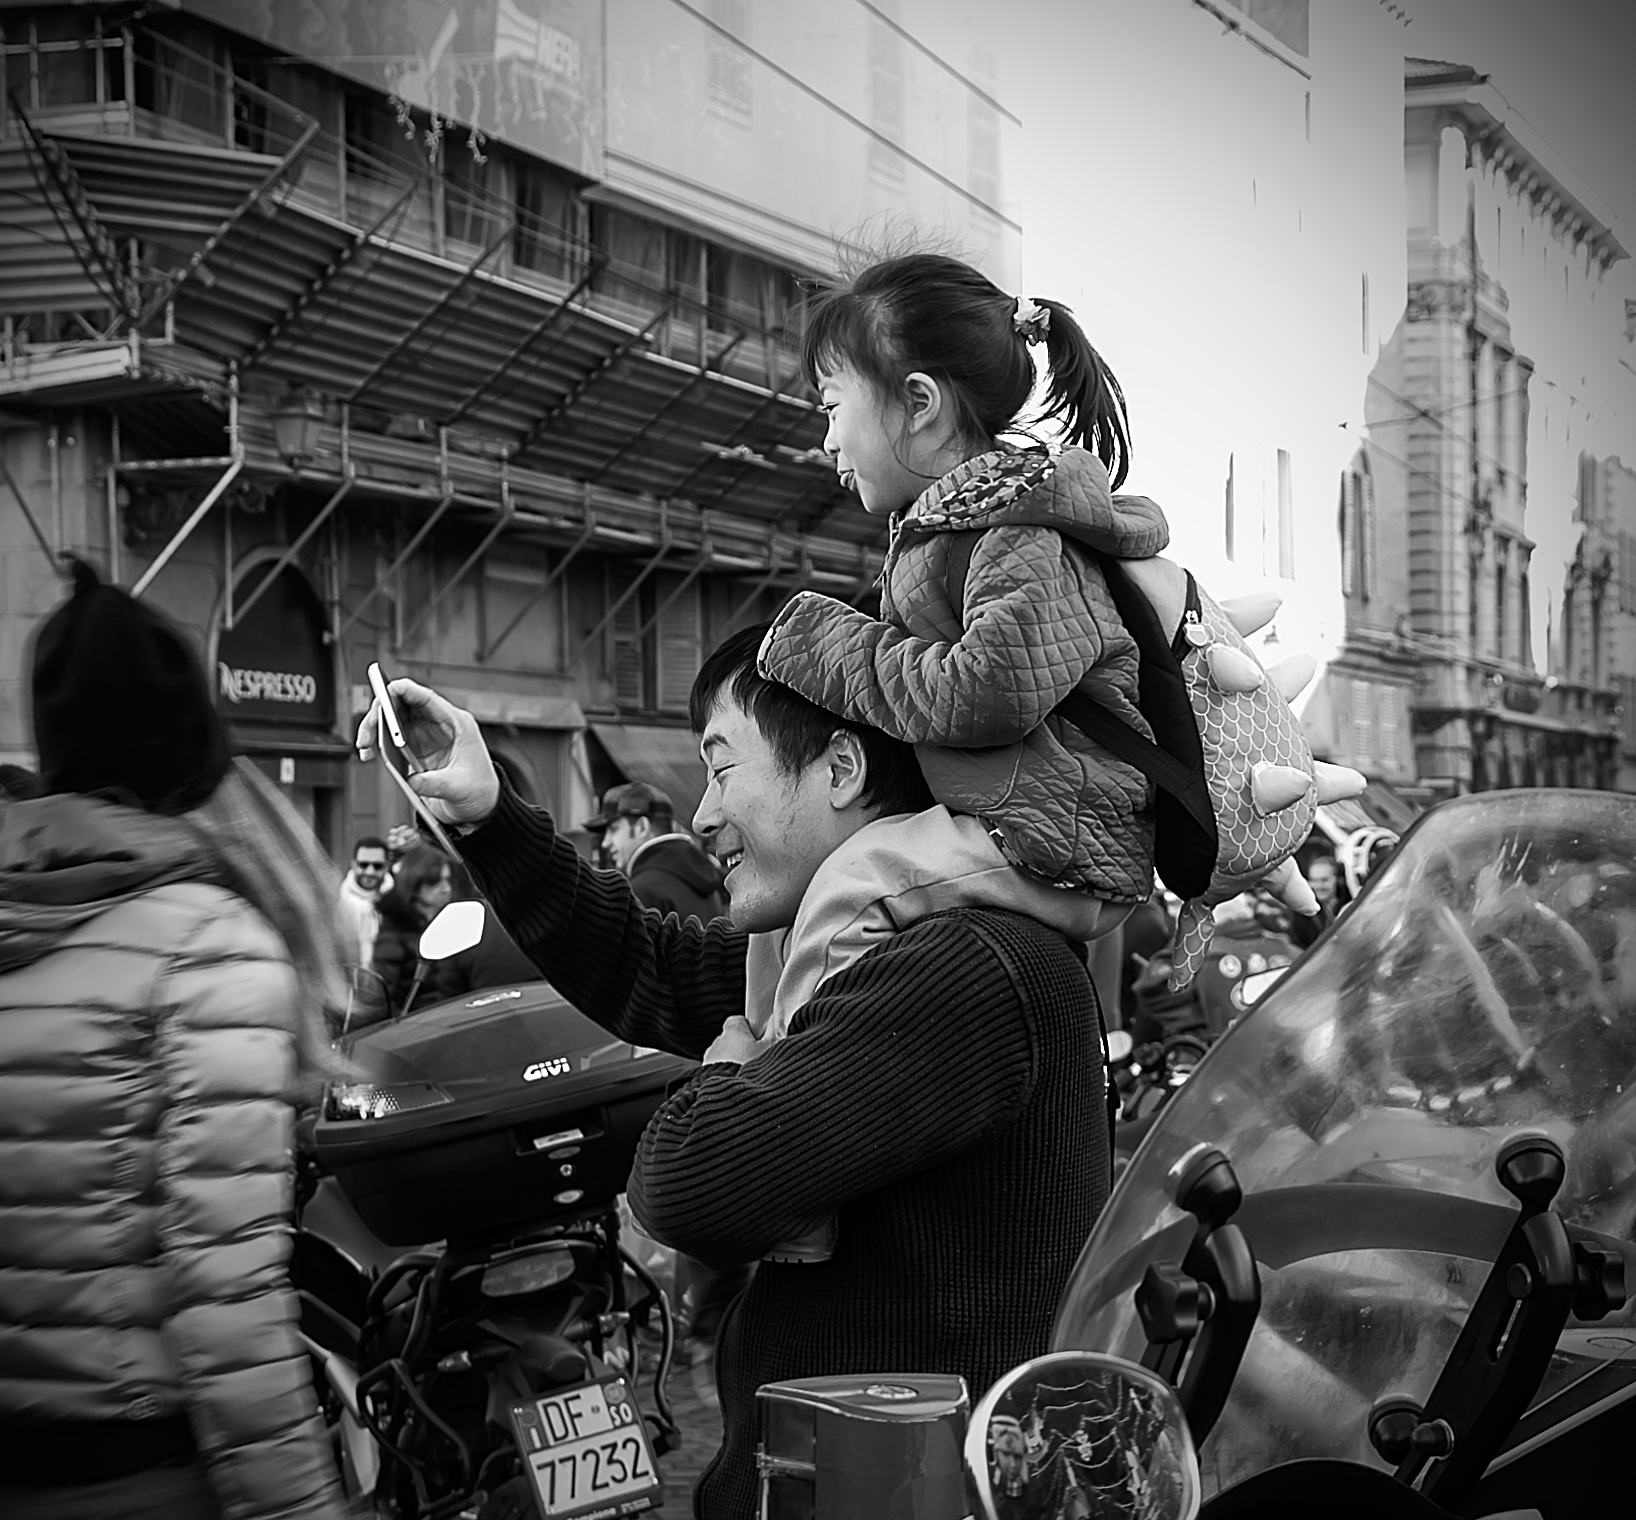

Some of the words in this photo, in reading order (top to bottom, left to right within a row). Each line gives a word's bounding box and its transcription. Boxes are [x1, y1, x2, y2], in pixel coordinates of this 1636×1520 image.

[217, 661, 316, 704] NESPRESSO
[523, 1057, 571, 1082] GIVI
[542, 1393, 584, 1443] DF
[536, 1437, 650, 1505] 77232
